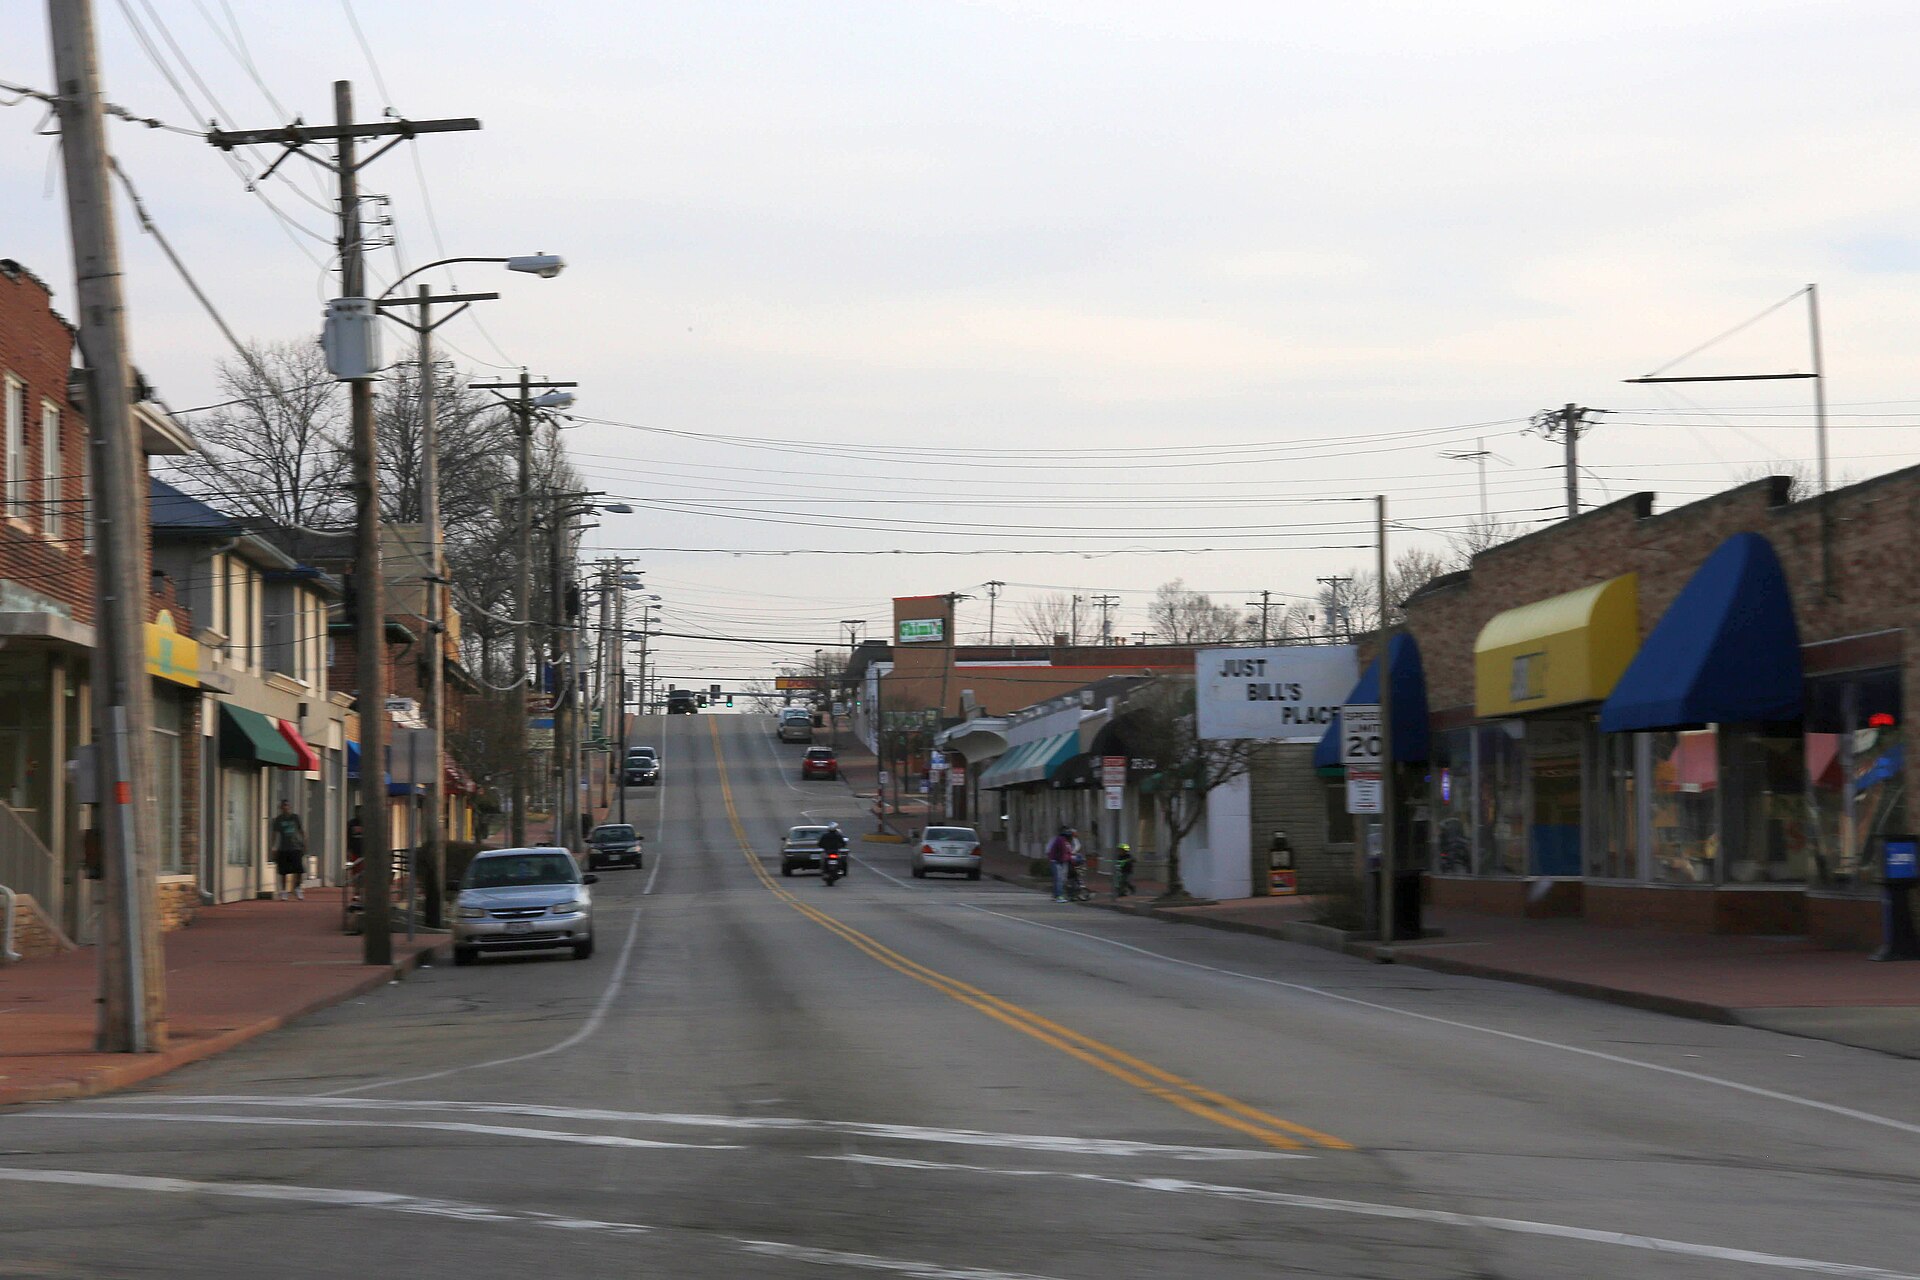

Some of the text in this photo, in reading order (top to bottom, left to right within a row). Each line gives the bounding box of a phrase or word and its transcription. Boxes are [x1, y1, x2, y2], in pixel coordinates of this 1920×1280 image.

[1219, 659, 1268, 678] JUST
[1246, 682, 1302, 702] BILL'S
[1343, 711, 1382, 721] SPEE
[1346, 735, 1384, 757] 20
